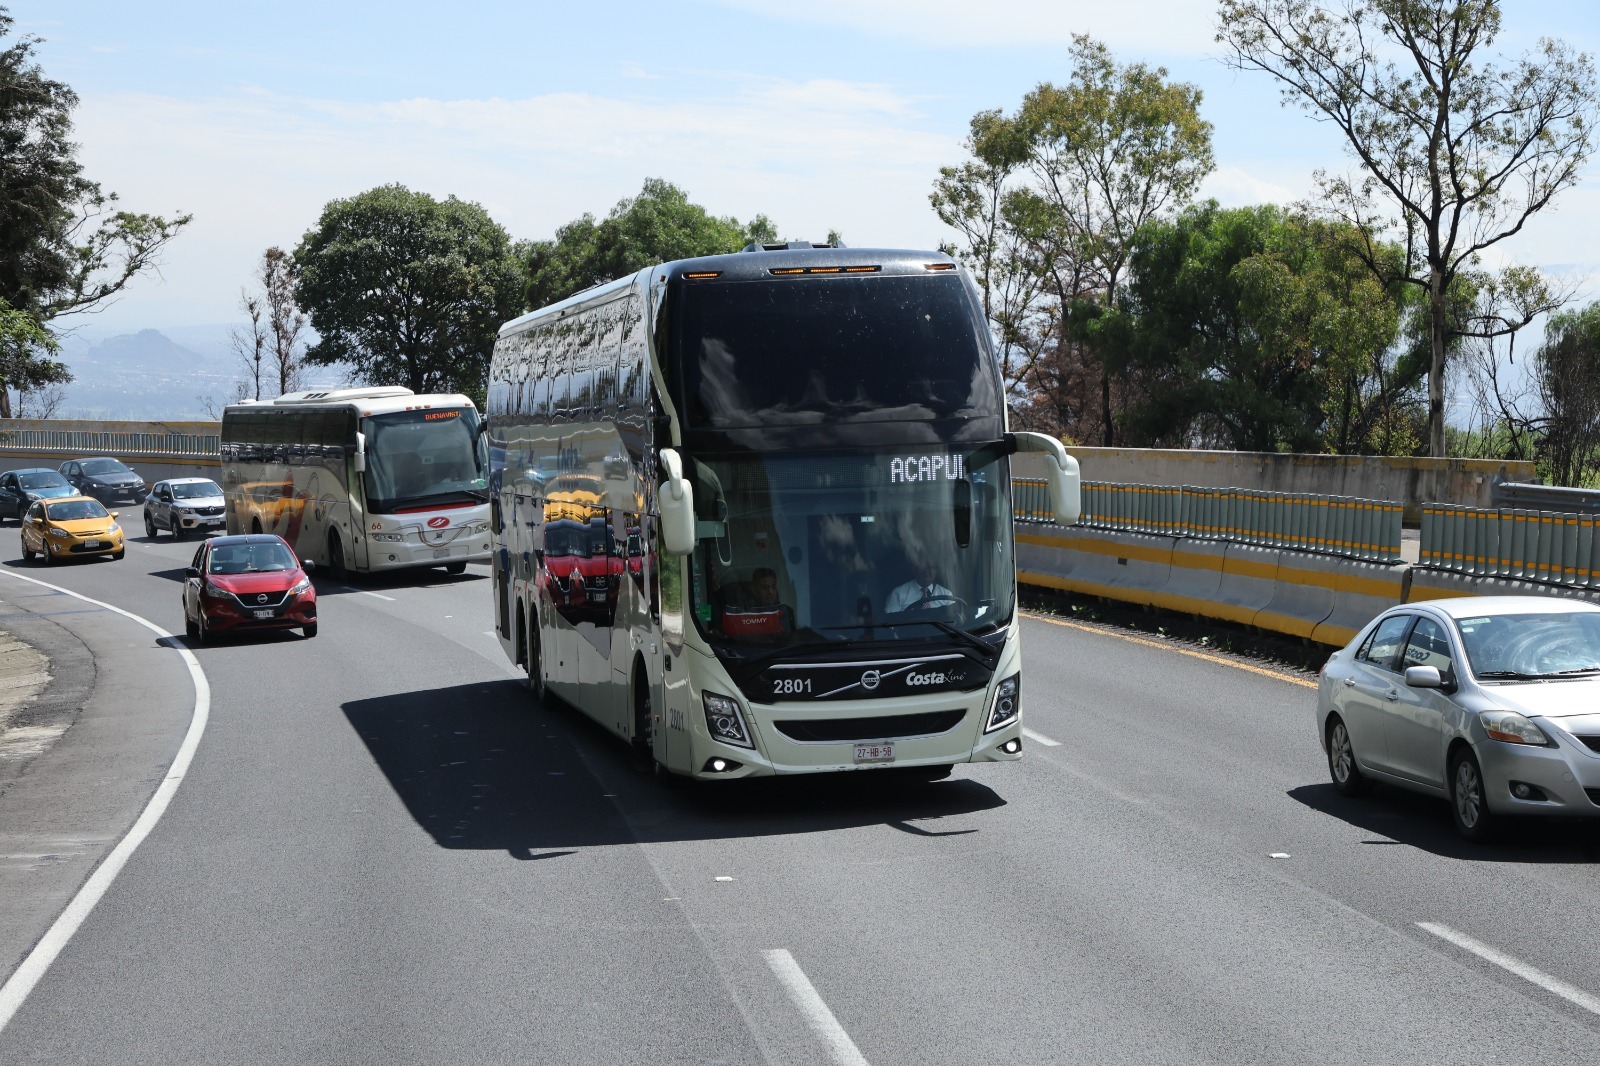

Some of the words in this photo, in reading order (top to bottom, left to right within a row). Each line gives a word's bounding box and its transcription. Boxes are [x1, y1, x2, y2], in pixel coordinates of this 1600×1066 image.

[371, 522, 382, 530] 66
[742, 617, 767, 625] TOMMY
[773, 679, 812, 694] 2801
[670, 707, 685, 733] 2801
